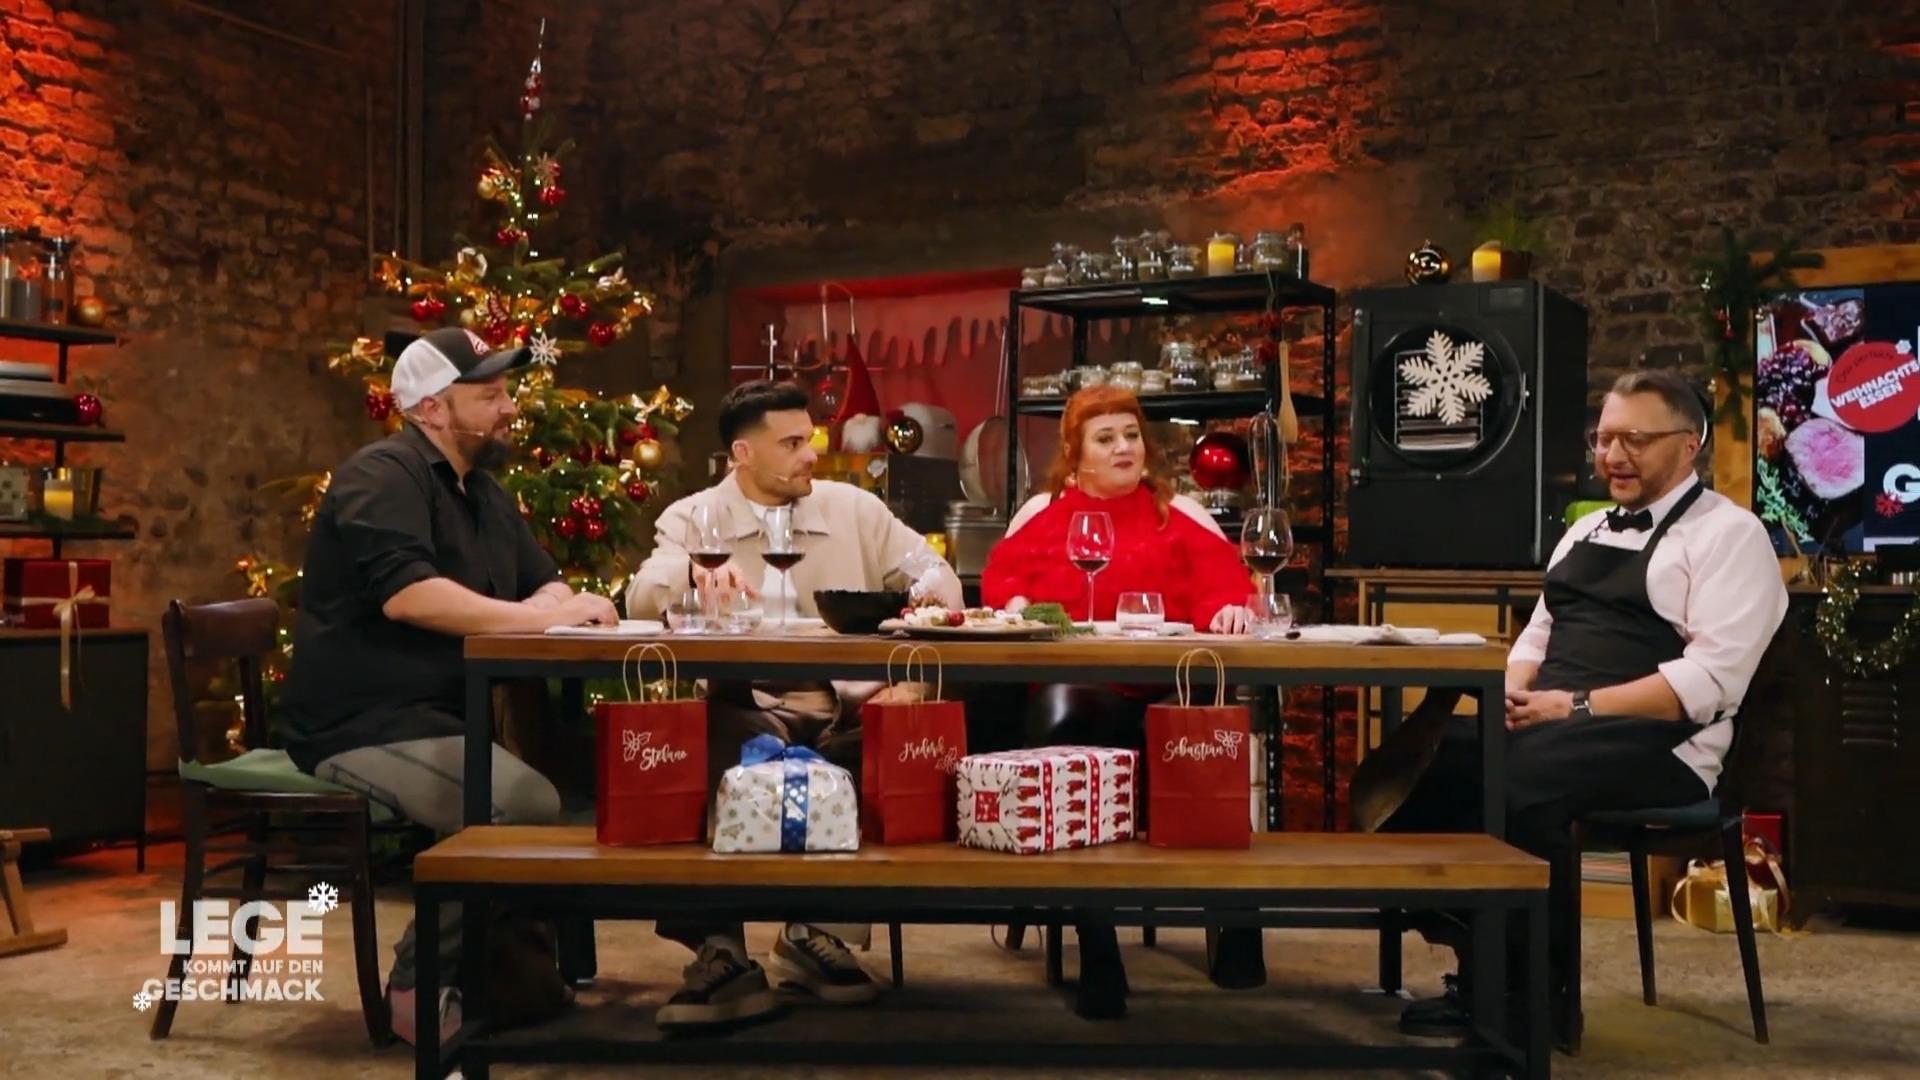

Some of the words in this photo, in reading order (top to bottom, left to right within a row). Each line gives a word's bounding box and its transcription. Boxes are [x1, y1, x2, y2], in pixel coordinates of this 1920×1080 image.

[1859, 380, 1903, 409] ESSEN
[640, 744, 687, 771] Stefano
[1162, 736, 1224, 762] Sebastian
